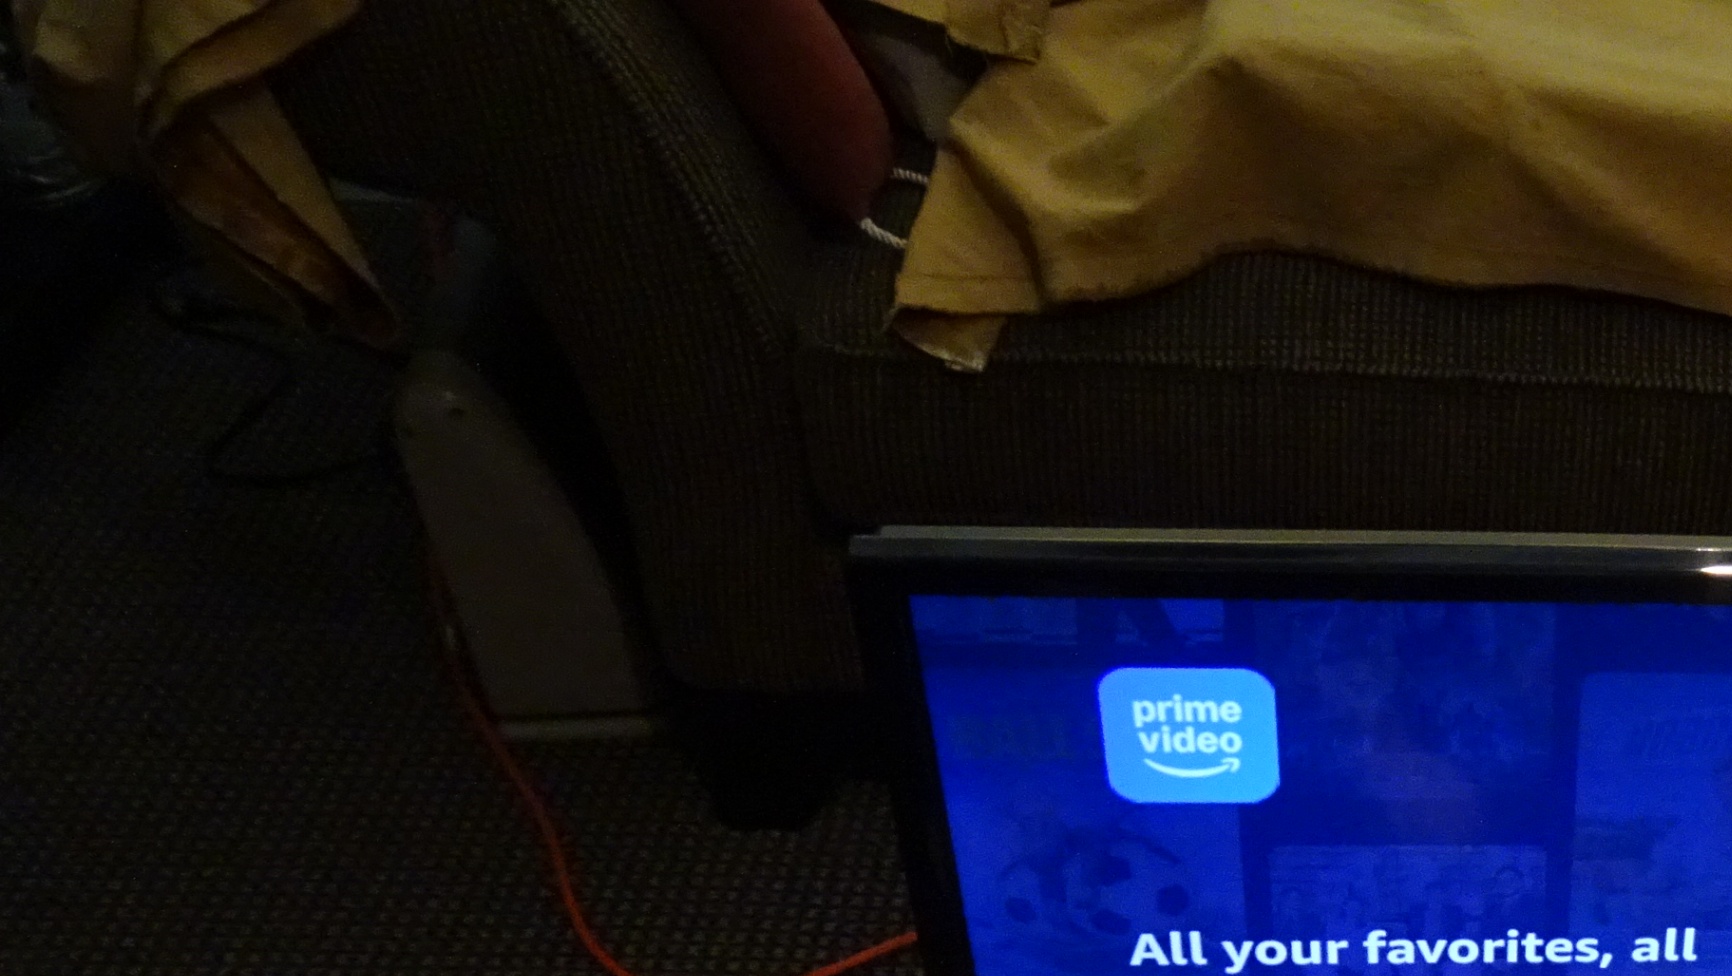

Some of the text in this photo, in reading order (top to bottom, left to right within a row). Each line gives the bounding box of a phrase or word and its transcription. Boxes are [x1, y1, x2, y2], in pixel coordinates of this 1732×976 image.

[1132, 694, 1242, 728] prime
[1138, 725, 1242, 753] video
[1129, 927, 1697, 974] All your favorites, all
